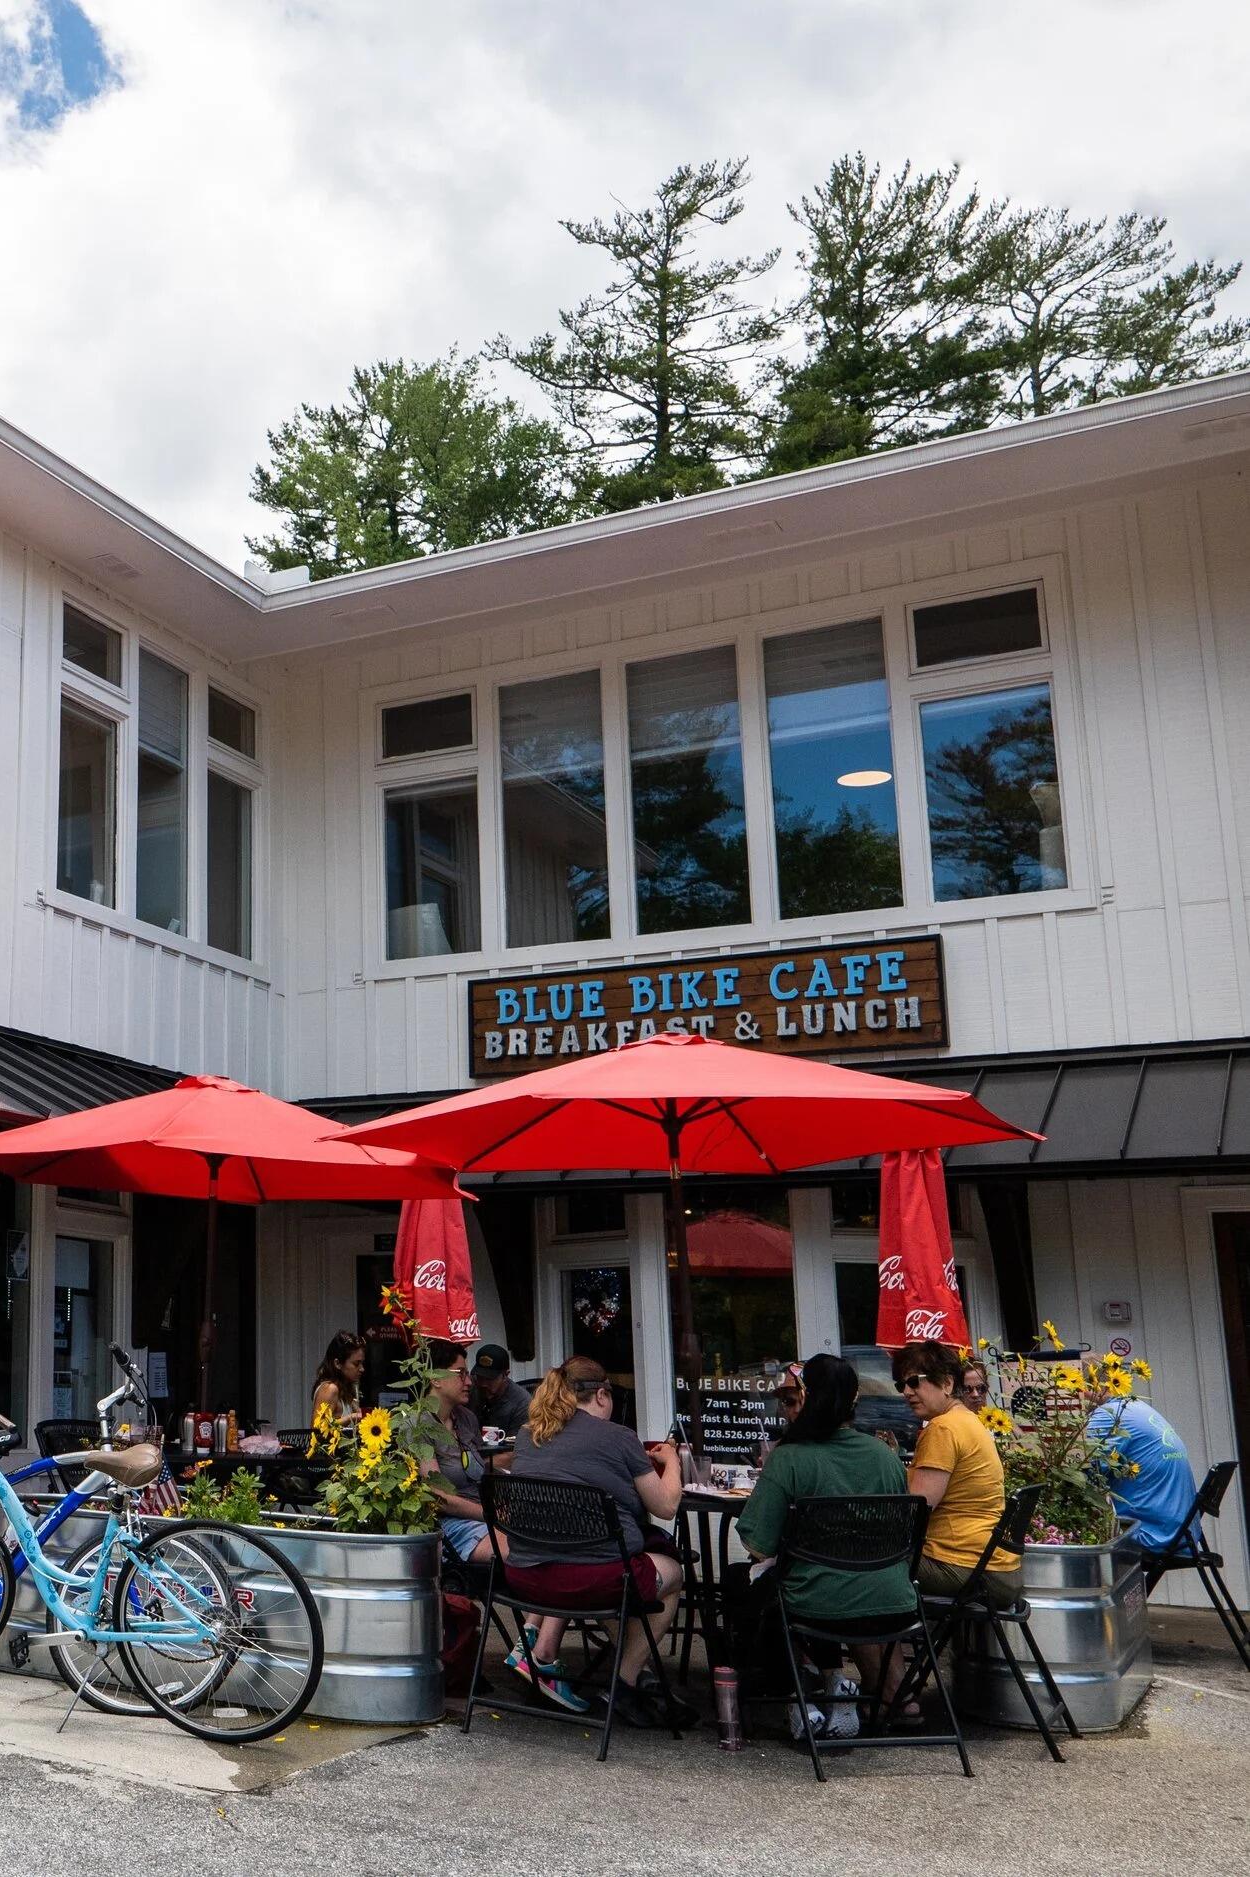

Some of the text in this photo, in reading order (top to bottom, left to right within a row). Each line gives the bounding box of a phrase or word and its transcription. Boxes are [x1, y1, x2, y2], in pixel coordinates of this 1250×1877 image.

[495, 951, 908, 1025] BLUE BIKE CAFE
[734, 1011, 761, 1041] &
[776, 996, 922, 1036] LUNCH
[718, 1379, 750, 1391] BIKE
[705, 1398, 730, 1409] 7am
[740, 1399, 765, 1411] 3pm
[676, 1413, 721, 1423] Brefast
[723, 1414, 731, 1423] &
[732, 1415, 761, 1425] Lunch
[763, 1416, 777, 1425] All
[704, 1429, 770, 1440] 828.526.9922
